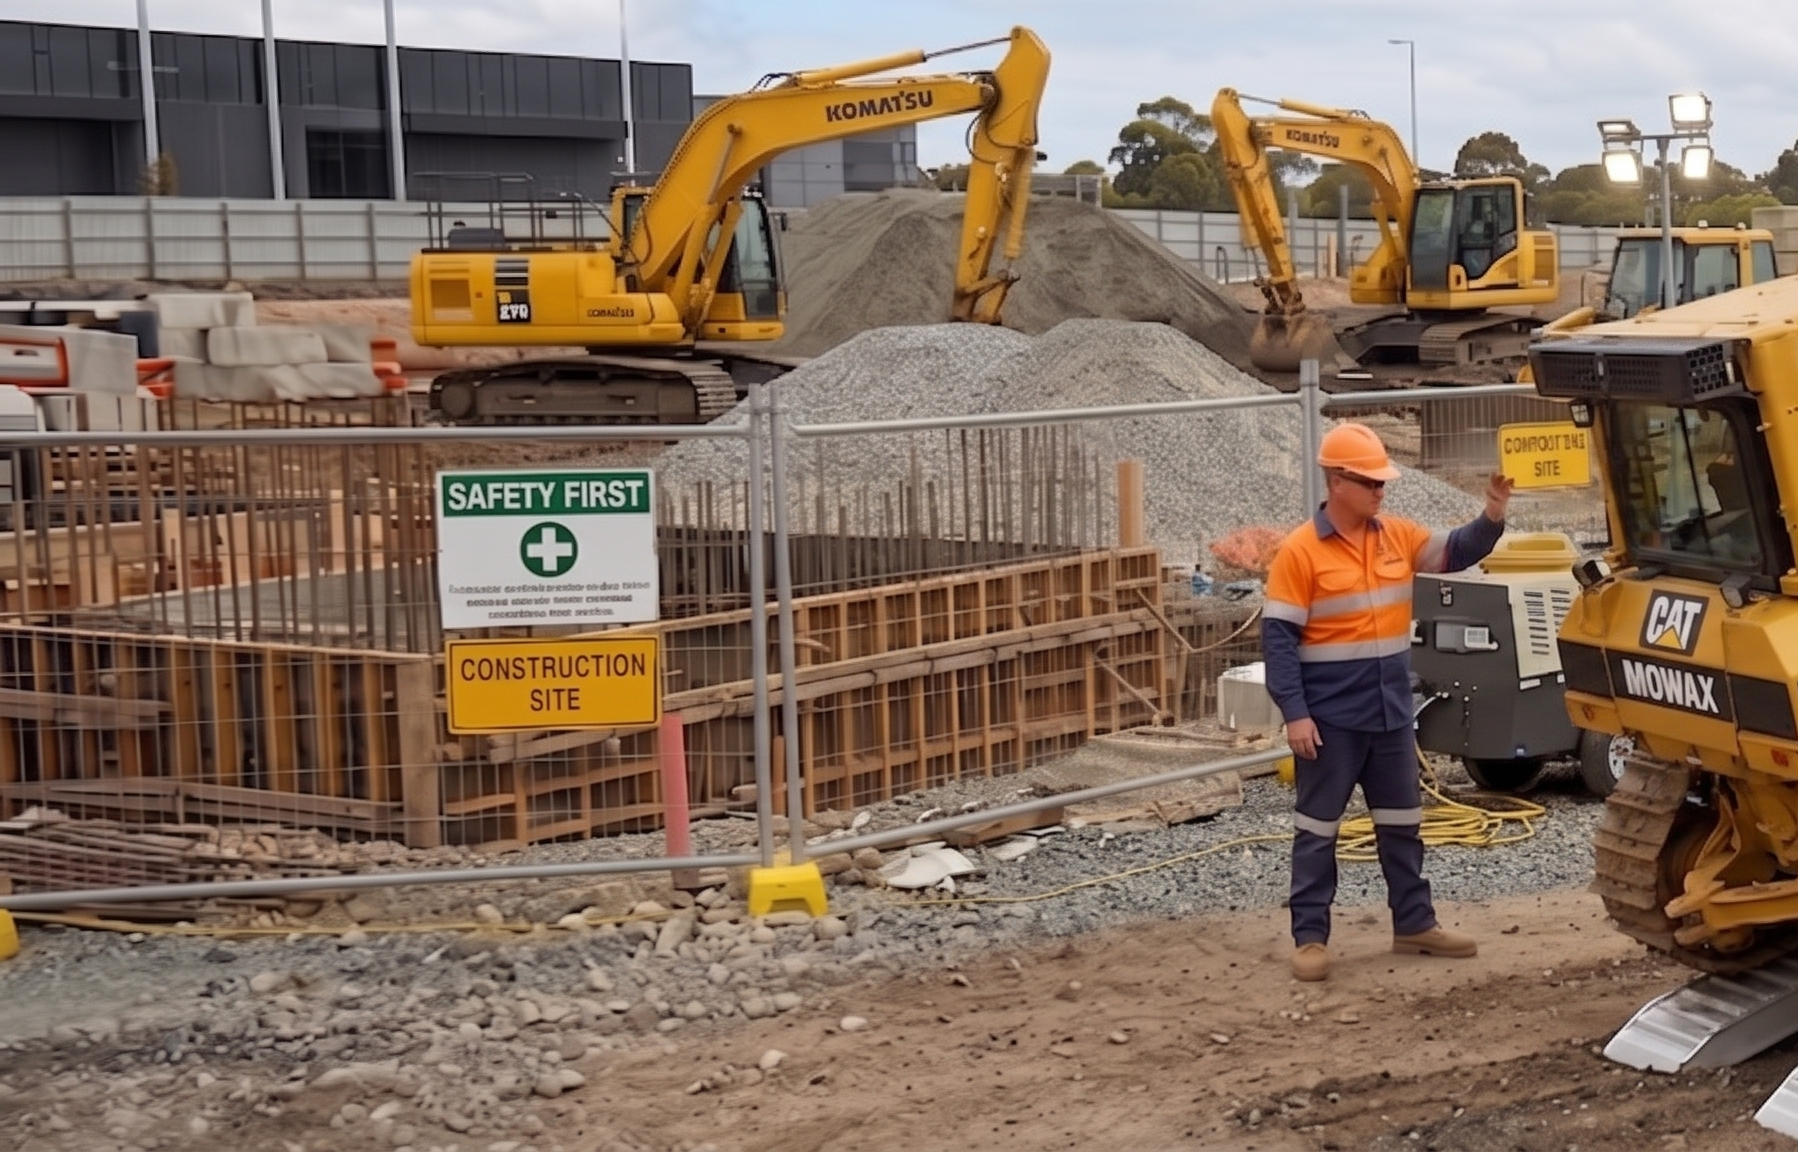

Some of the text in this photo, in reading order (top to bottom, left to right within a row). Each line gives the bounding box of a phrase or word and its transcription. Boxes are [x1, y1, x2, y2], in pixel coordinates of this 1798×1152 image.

[826, 90, 933, 122] KOMATSU
[1534, 460, 1561, 477] SITE
[449, 480, 644, 511] SAFETY FIRST
[1646, 596, 1703, 650] CAT
[461, 653, 645, 681] CONSTRUCTION
[530, 688, 581, 711] SITE
[1622, 659, 1719, 714] MOWAX
